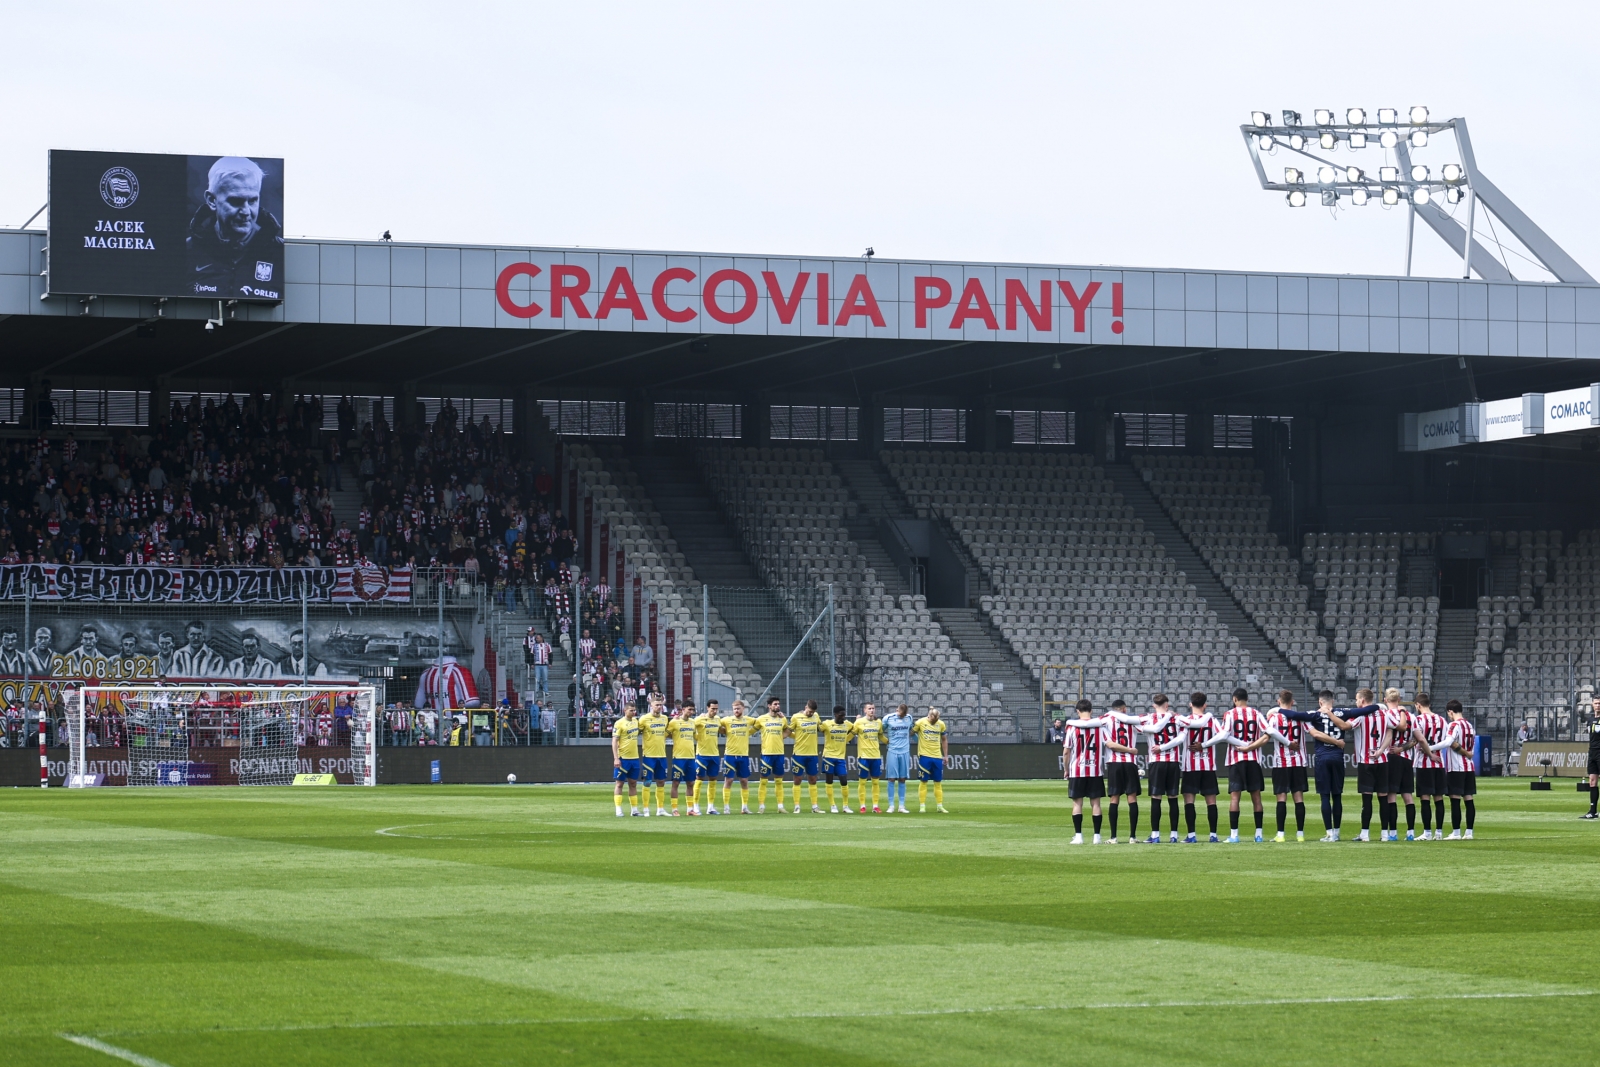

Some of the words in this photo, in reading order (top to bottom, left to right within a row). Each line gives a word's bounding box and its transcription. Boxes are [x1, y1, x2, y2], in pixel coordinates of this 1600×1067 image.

[95, 219, 144, 234] JACEK
[83, 235, 156, 250] MAGIERA
[253, 288, 279, 300] ORLEN
[495, 262, 886, 328] CRACOVIA
[915, 276, 1125, 335] PANY!
[1550, 400, 1591, 420] COMARC
[1423, 420, 1459, 438] COMARC
[56, 566, 174, 601] SEKTOR
[181, 567, 339, 602] RODZINNY
[51, 657, 160, 680] 21.08.1921
[1117, 727, 1129, 747] 6
[1233, 719, 1257, 742] 99
[1370, 720, 1381, 741] 4
[1079, 733, 1097, 753] 14
[319, 757, 366, 774] SPORT
[1567, 752, 1590, 768] SPORT
